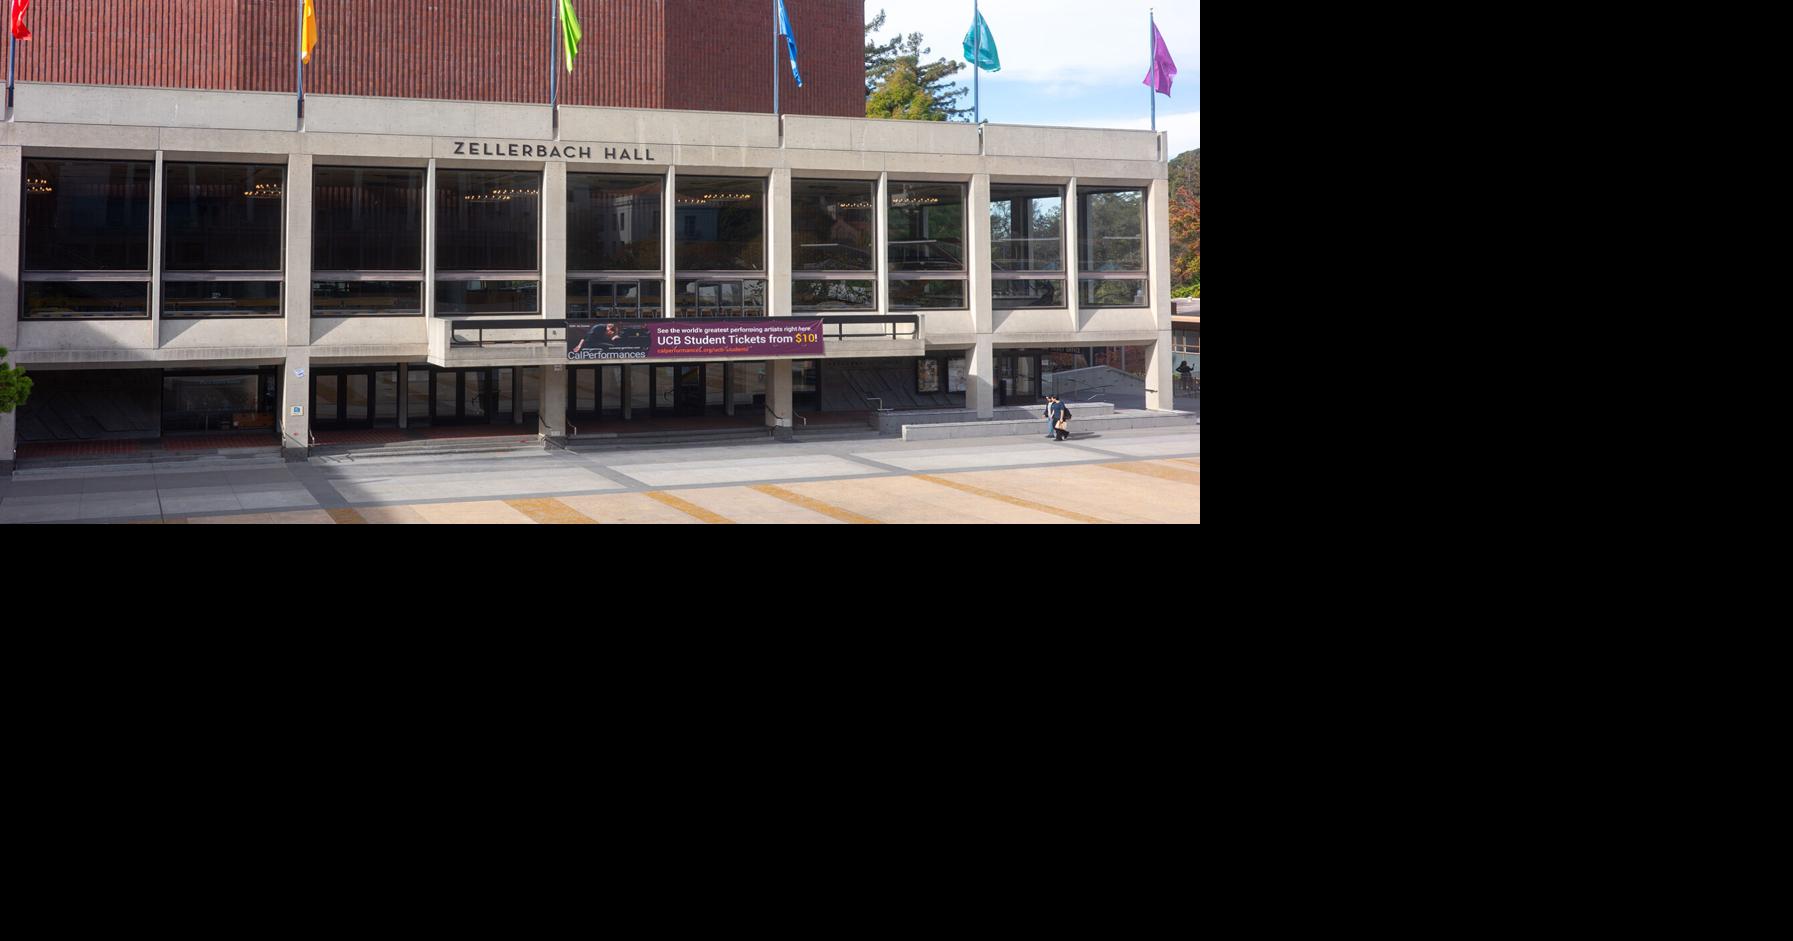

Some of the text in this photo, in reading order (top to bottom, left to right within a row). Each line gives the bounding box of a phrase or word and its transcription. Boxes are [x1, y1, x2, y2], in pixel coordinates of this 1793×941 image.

[453, 141, 655, 161] ZELLERBACH HALL
[730, 326, 763, 334] performing
[657, 333, 818, 346] UCB Student Tickets from $10!
